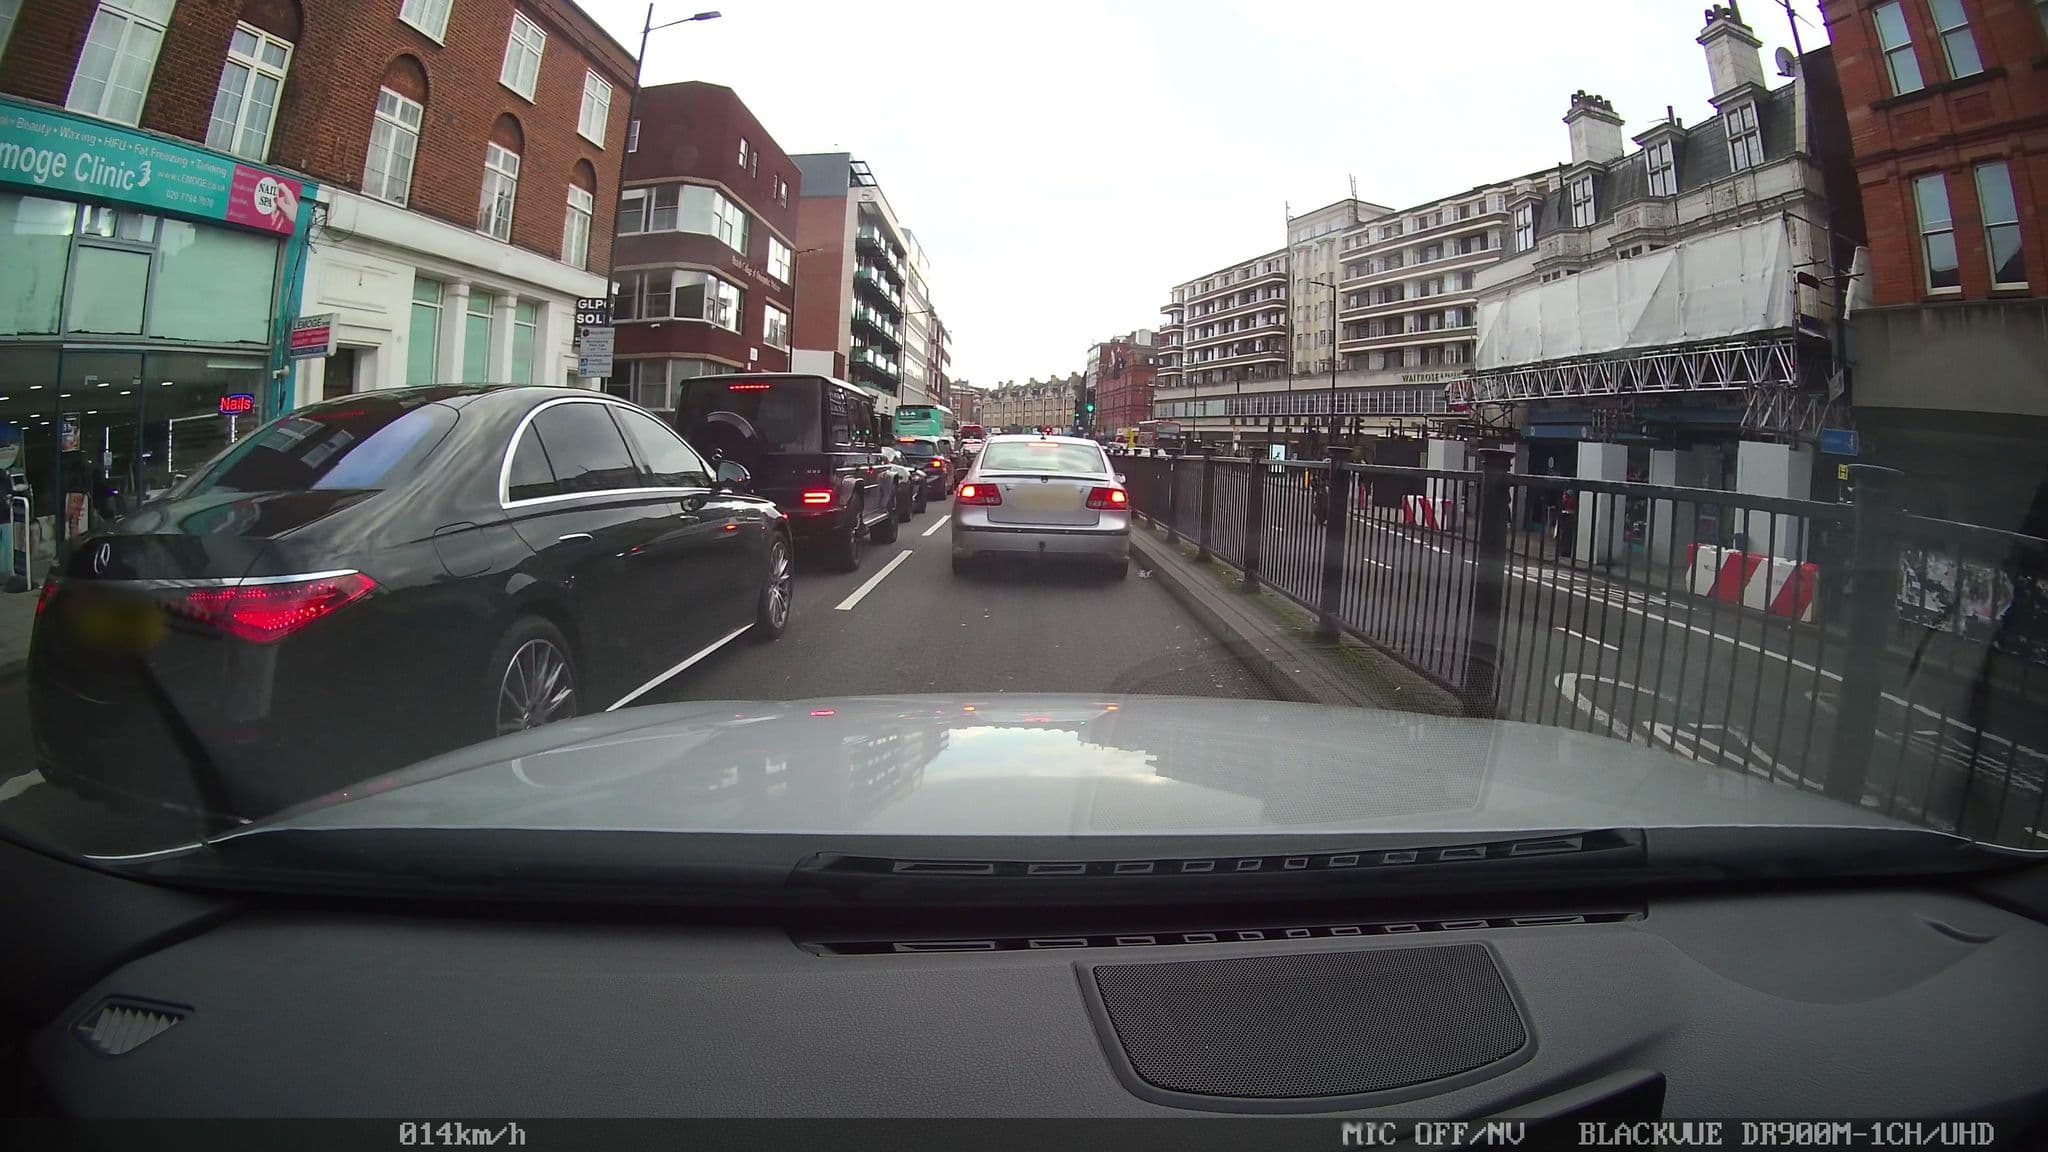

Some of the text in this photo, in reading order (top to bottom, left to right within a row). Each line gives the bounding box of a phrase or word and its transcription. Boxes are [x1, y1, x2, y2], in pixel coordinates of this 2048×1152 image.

[16, 116, 51, 136] Beauty
[60, 126, 97, 147] Waxing
[75, 152, 136, 191] Clinic
[259, 183, 278, 208] NAIL SPA
[220, 397, 251, 411] Nails
